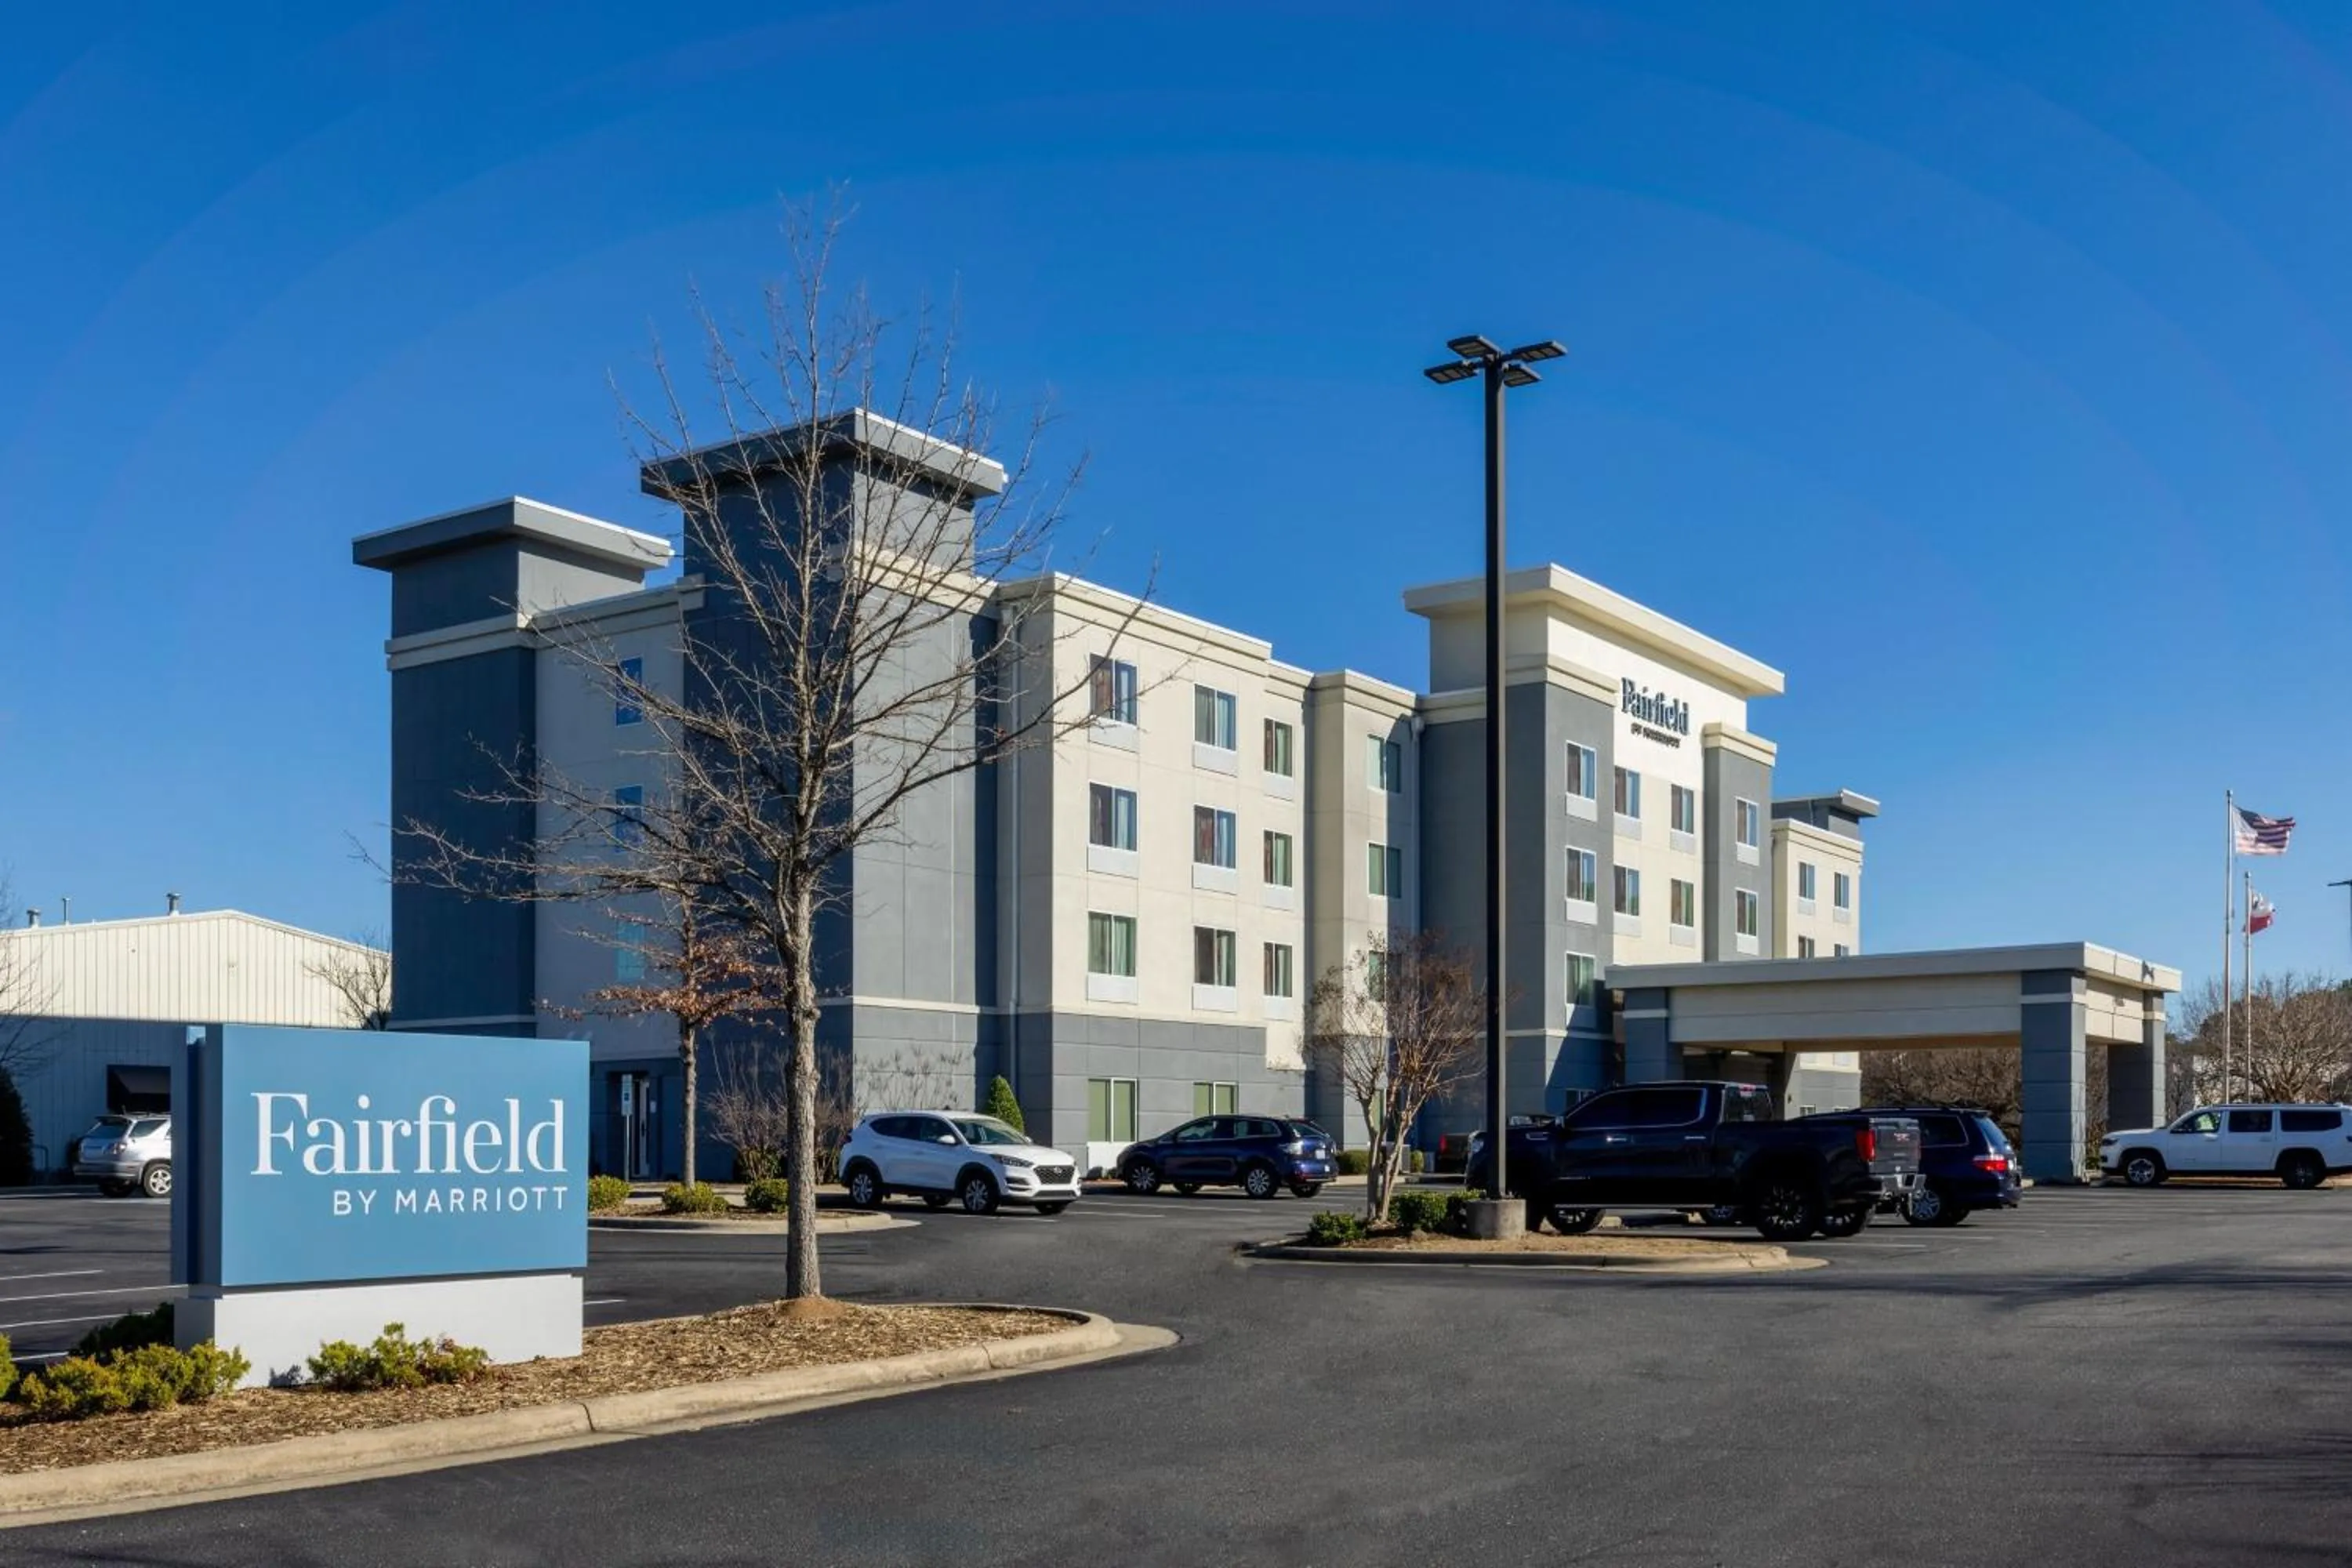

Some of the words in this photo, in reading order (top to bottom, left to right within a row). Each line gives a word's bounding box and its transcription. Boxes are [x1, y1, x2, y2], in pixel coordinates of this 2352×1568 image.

[250, 1092, 568, 1175] Fairfield
[333, 1189, 377, 1215] BY
[395, 1186, 568, 1214] MARRIOTT
